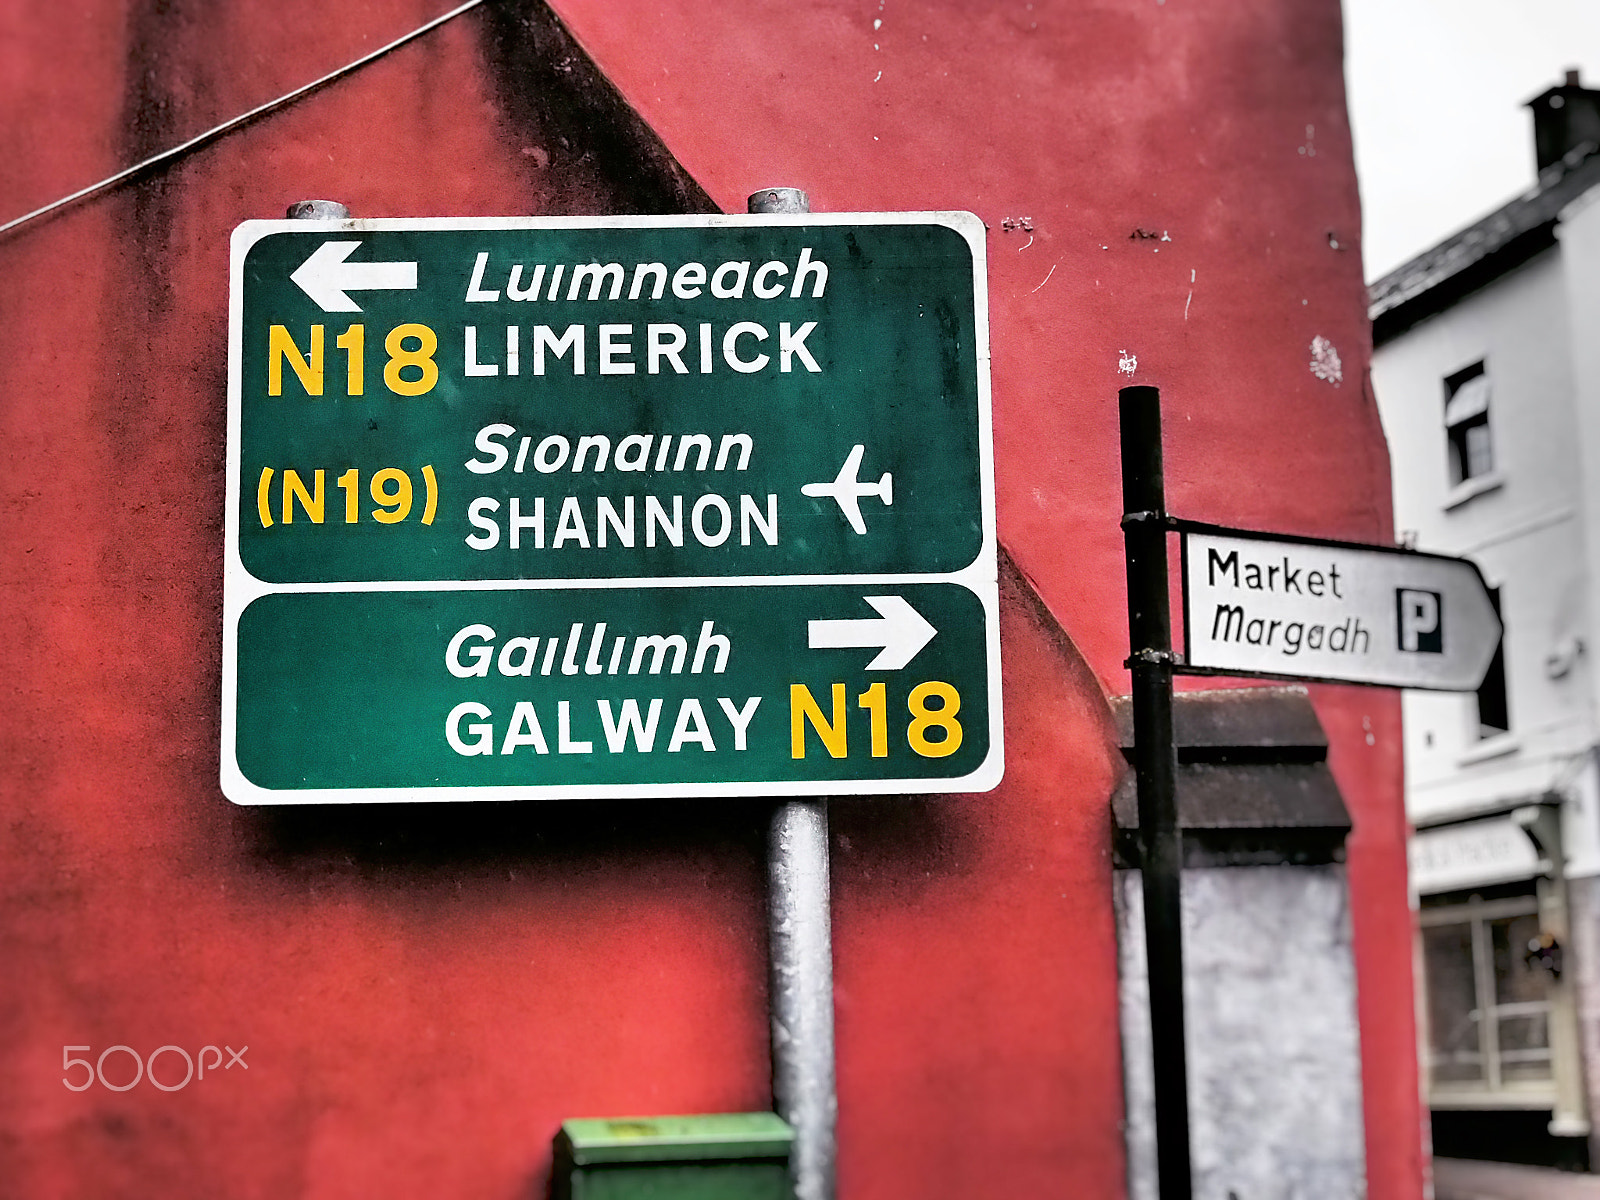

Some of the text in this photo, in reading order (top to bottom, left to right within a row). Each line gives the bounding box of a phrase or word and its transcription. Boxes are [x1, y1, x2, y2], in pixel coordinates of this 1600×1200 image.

[267, 323, 439, 397] N18
[464, 321, 823, 377] LIMERICK
[257, 464, 439, 529] (N19)
[465, 493, 779, 551] SHANNON
[1208, 547, 1343, 599] Market
[1211, 602, 1371, 656] Margadh
[445, 696, 763, 757] GALWAY
[789, 680, 964, 760] N18
